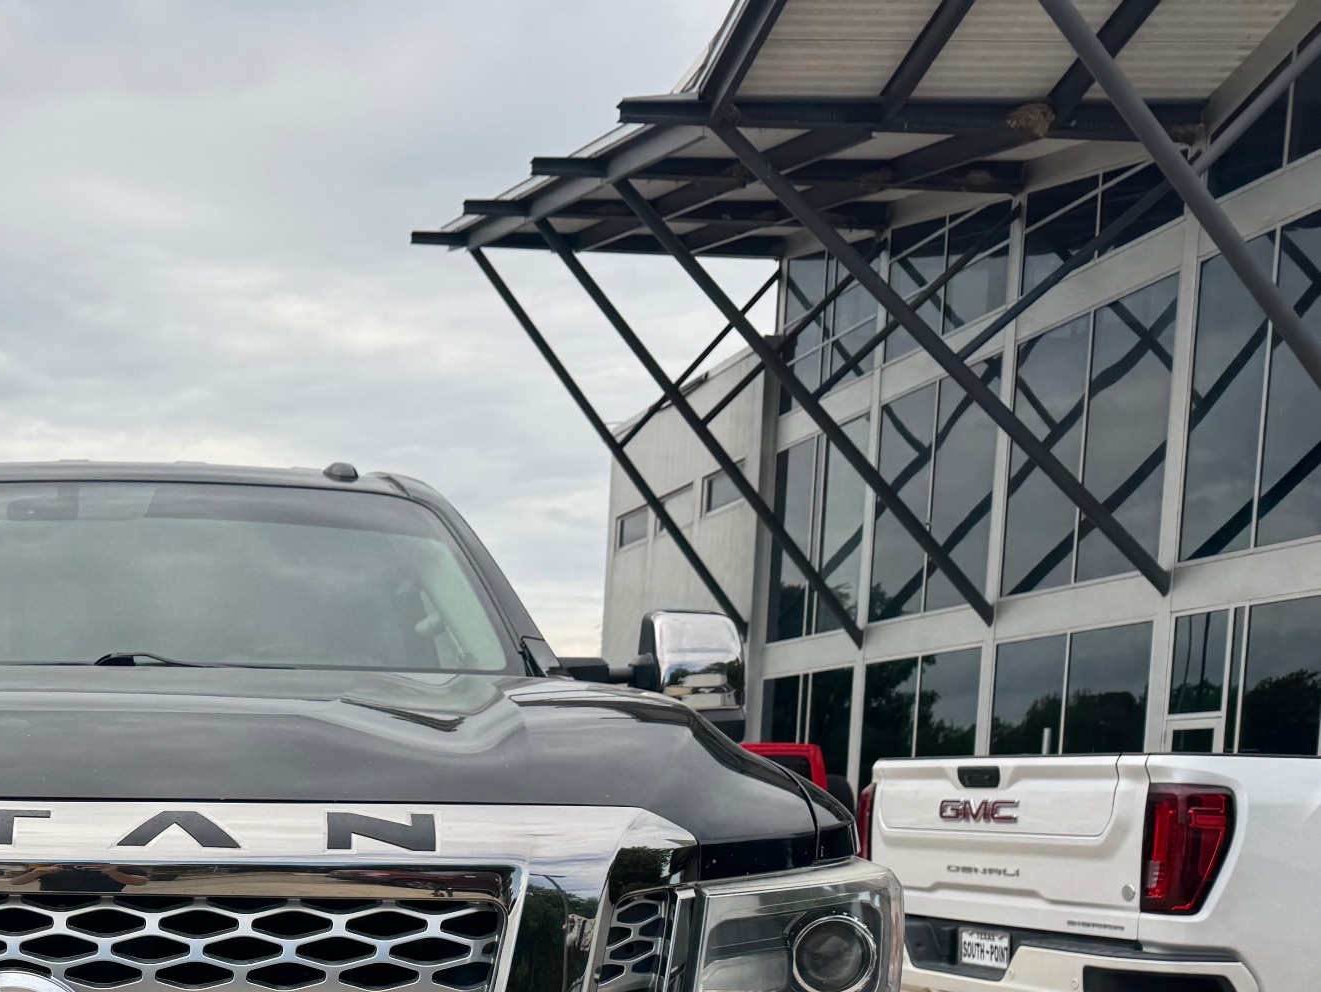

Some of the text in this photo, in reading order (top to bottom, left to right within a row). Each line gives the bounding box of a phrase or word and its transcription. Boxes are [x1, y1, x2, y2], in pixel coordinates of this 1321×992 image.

[939, 798, 1020, 824] GMC
[946, 865, 1020, 877] DENALI
[963, 940, 985, 960] SOUTH
